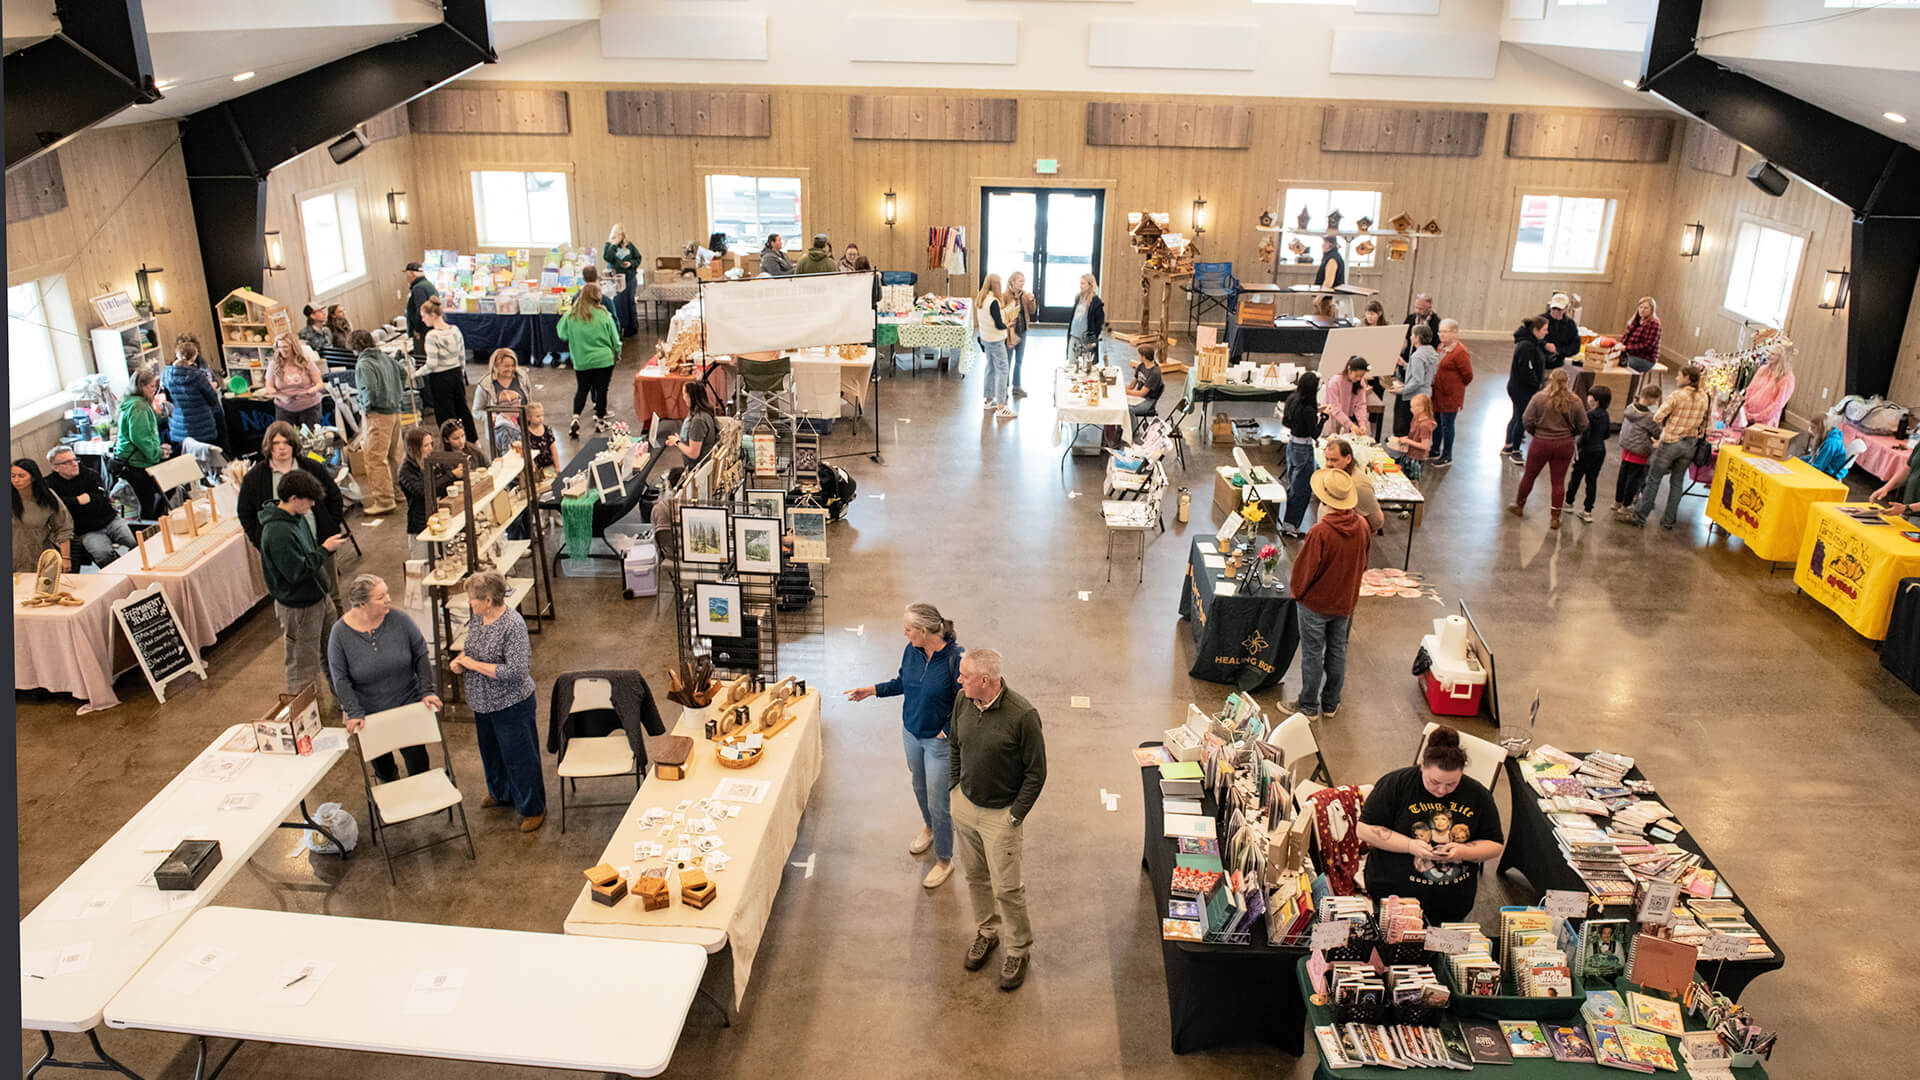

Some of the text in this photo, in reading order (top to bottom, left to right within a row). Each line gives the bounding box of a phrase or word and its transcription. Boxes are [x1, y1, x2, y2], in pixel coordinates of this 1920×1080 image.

[1214, 655, 1257, 665] HEALING
[1408, 801, 1474, 817] Thug Life
[1541, 969, 1562, 977] STAR
[1539, 976, 1564, 984] WARS
